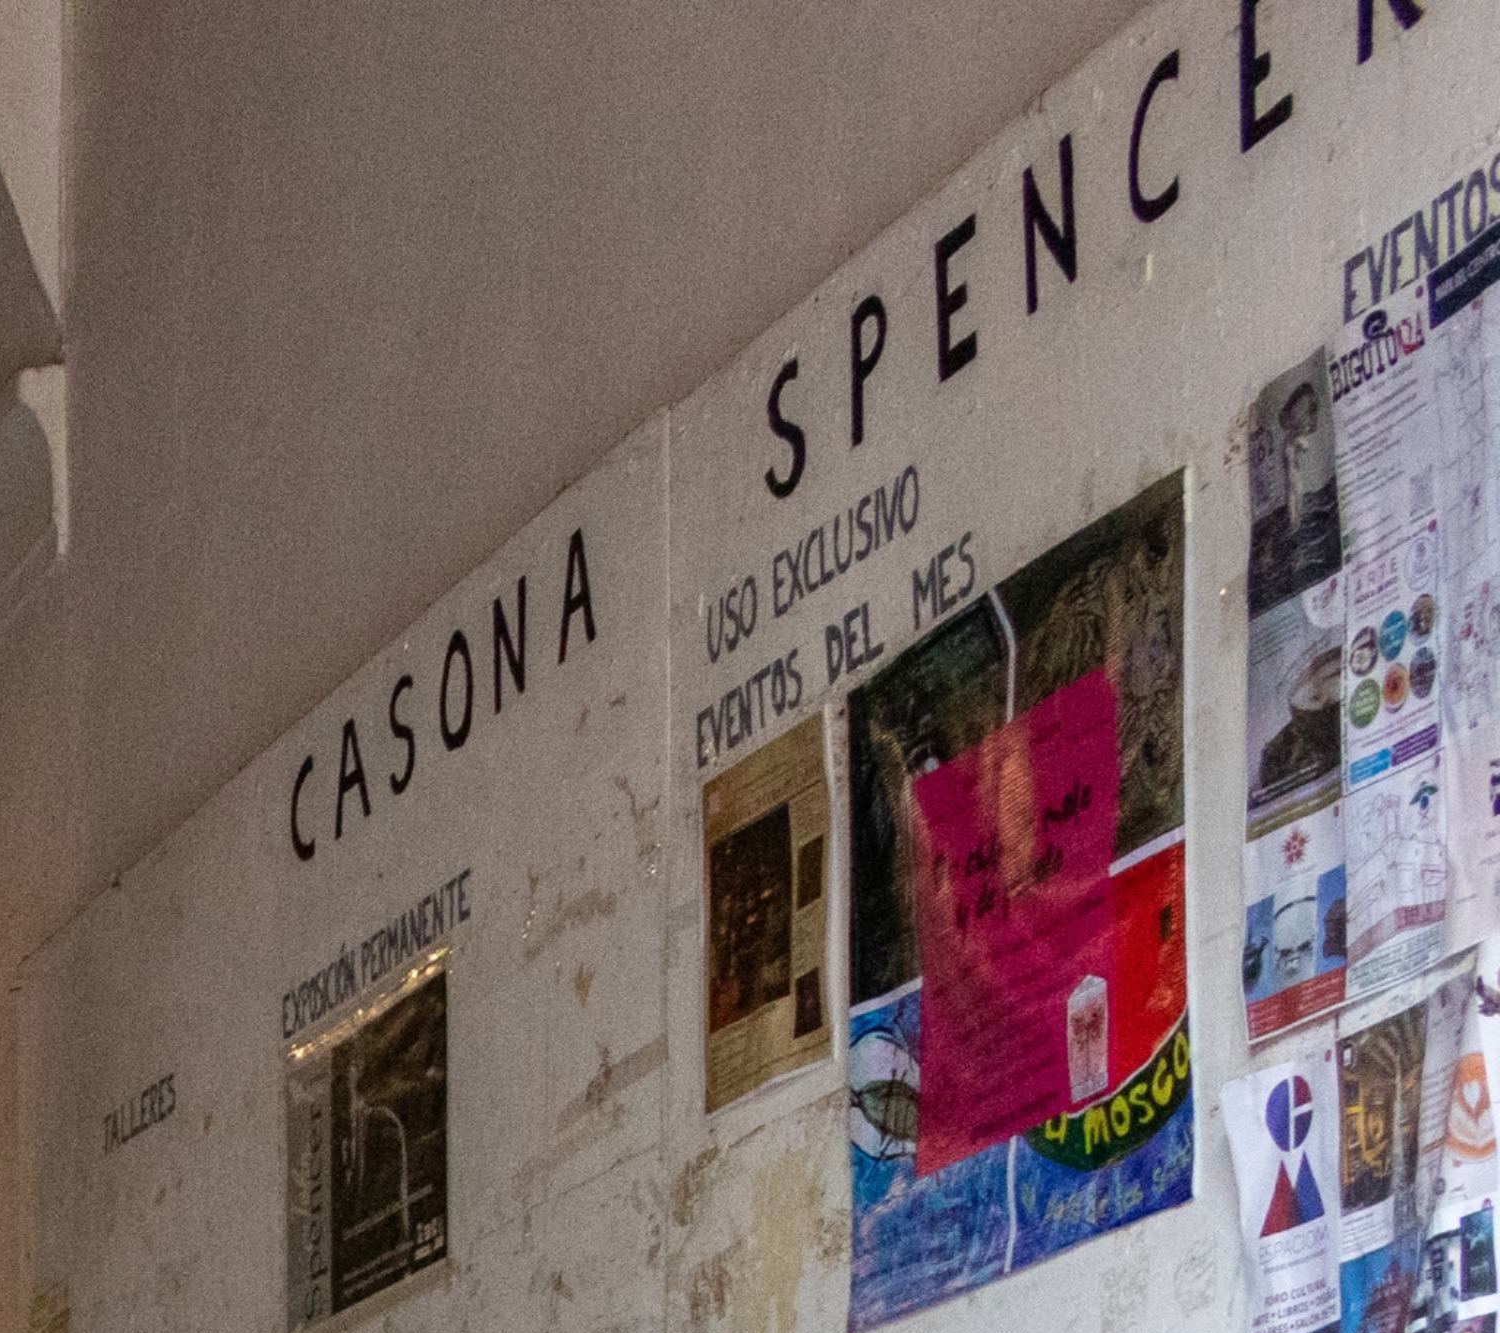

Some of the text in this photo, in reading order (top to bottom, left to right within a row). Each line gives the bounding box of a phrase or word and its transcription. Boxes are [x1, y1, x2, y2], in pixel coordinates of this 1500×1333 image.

[696, 531, 976, 771] EVENTOS DEL MES
[706, 465, 920, 664] USO EXCLUSIVO
[290, 528, 596, 862] CASONA
[282, 867, 473, 1041] EXPOSICIÓN PERMANENTE
[103, 1073, 177, 1156] TALLERES
